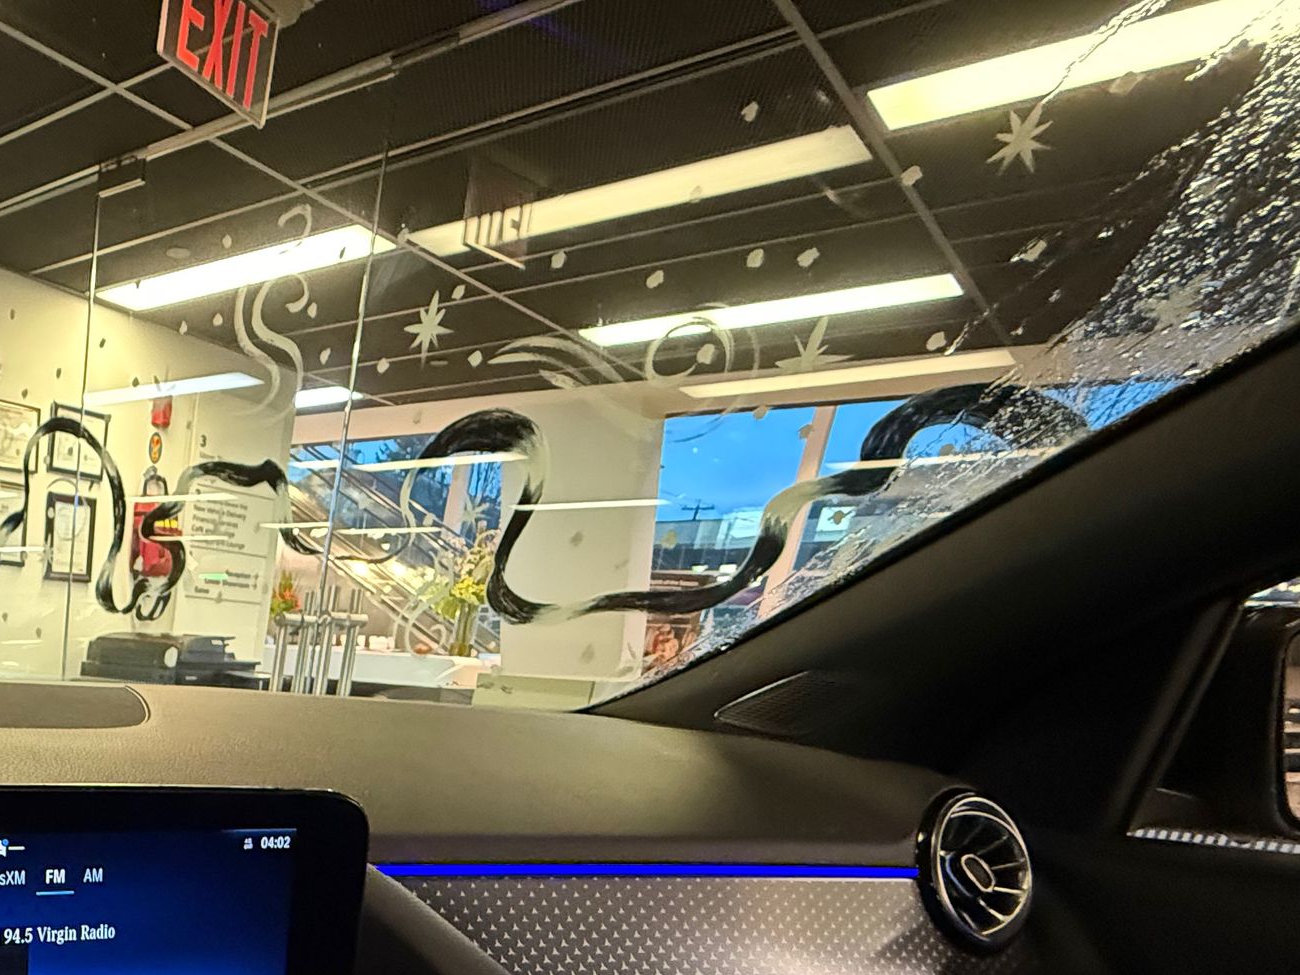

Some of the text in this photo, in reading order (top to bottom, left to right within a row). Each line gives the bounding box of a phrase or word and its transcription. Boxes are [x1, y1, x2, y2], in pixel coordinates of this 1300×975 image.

[176, 0, 269, 112] EXIT
[261, 836, 291, 849] 04:02
[45, 868, 66, 884] FM
[83, 867, 103, 883] AM
[4, 927, 33, 944] 94.5
[37, 925, 77, 945] Virgin
[80, 923, 115, 940] Radio
